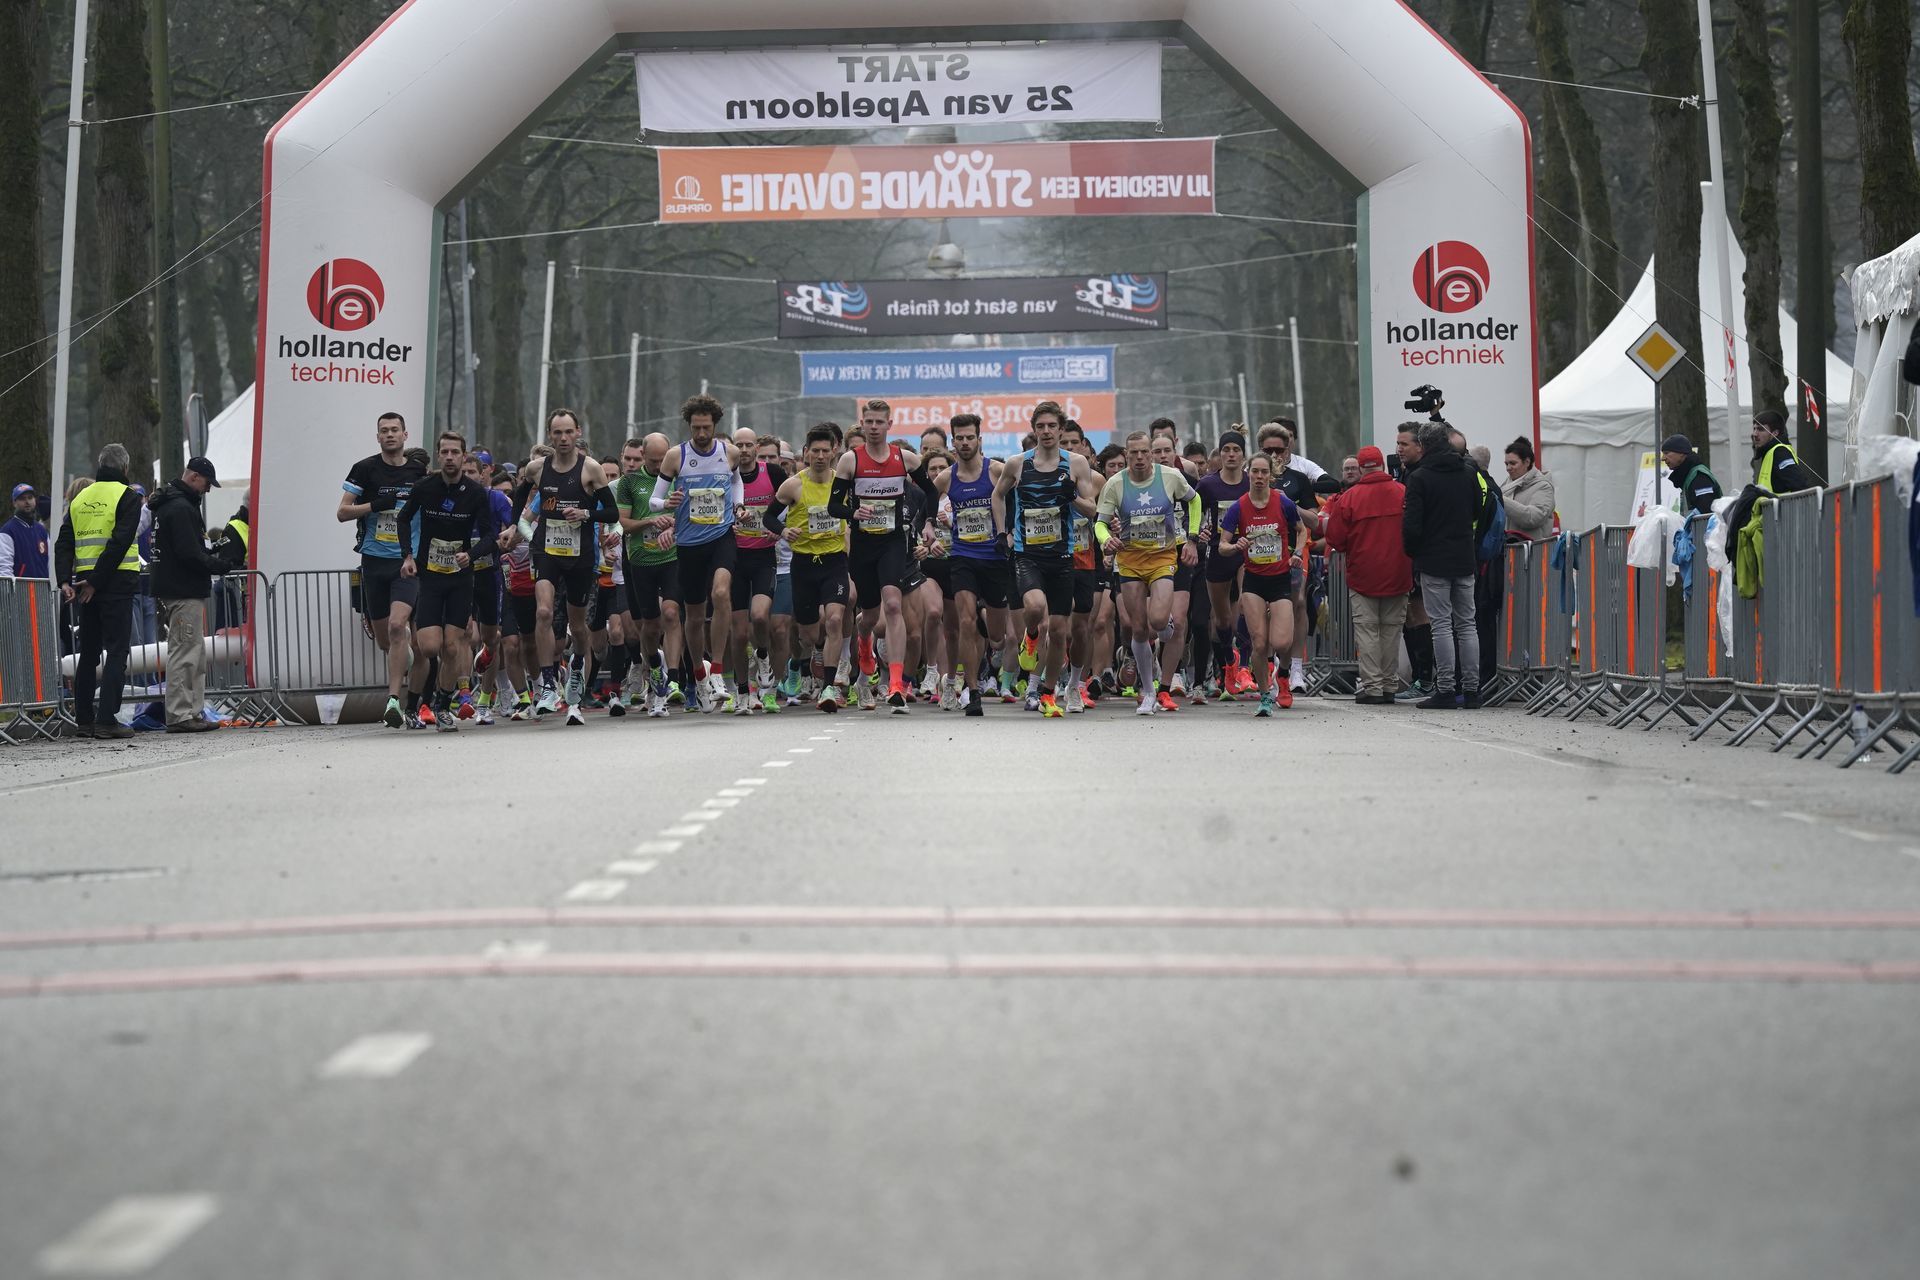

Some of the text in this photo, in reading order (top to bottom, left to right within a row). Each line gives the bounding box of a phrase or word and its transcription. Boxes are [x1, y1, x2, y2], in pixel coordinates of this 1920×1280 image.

[1387, 317, 1518, 344] hollander
[279, 335, 412, 362] hollander
[1401, 344, 1504, 367] techniek
[291, 362, 395, 385] techniek
[966, 498, 992, 507] WEERT
[698, 505, 718, 514] 20008
[1130, 506, 1163, 517] SAYSKY
[816, 520, 835, 530] 20014
[965, 524, 985, 533] 20026
[1033, 524, 1054, 534] 20018
[553, 537, 573, 546] 20033
[1255, 545, 1275, 554] 20032
